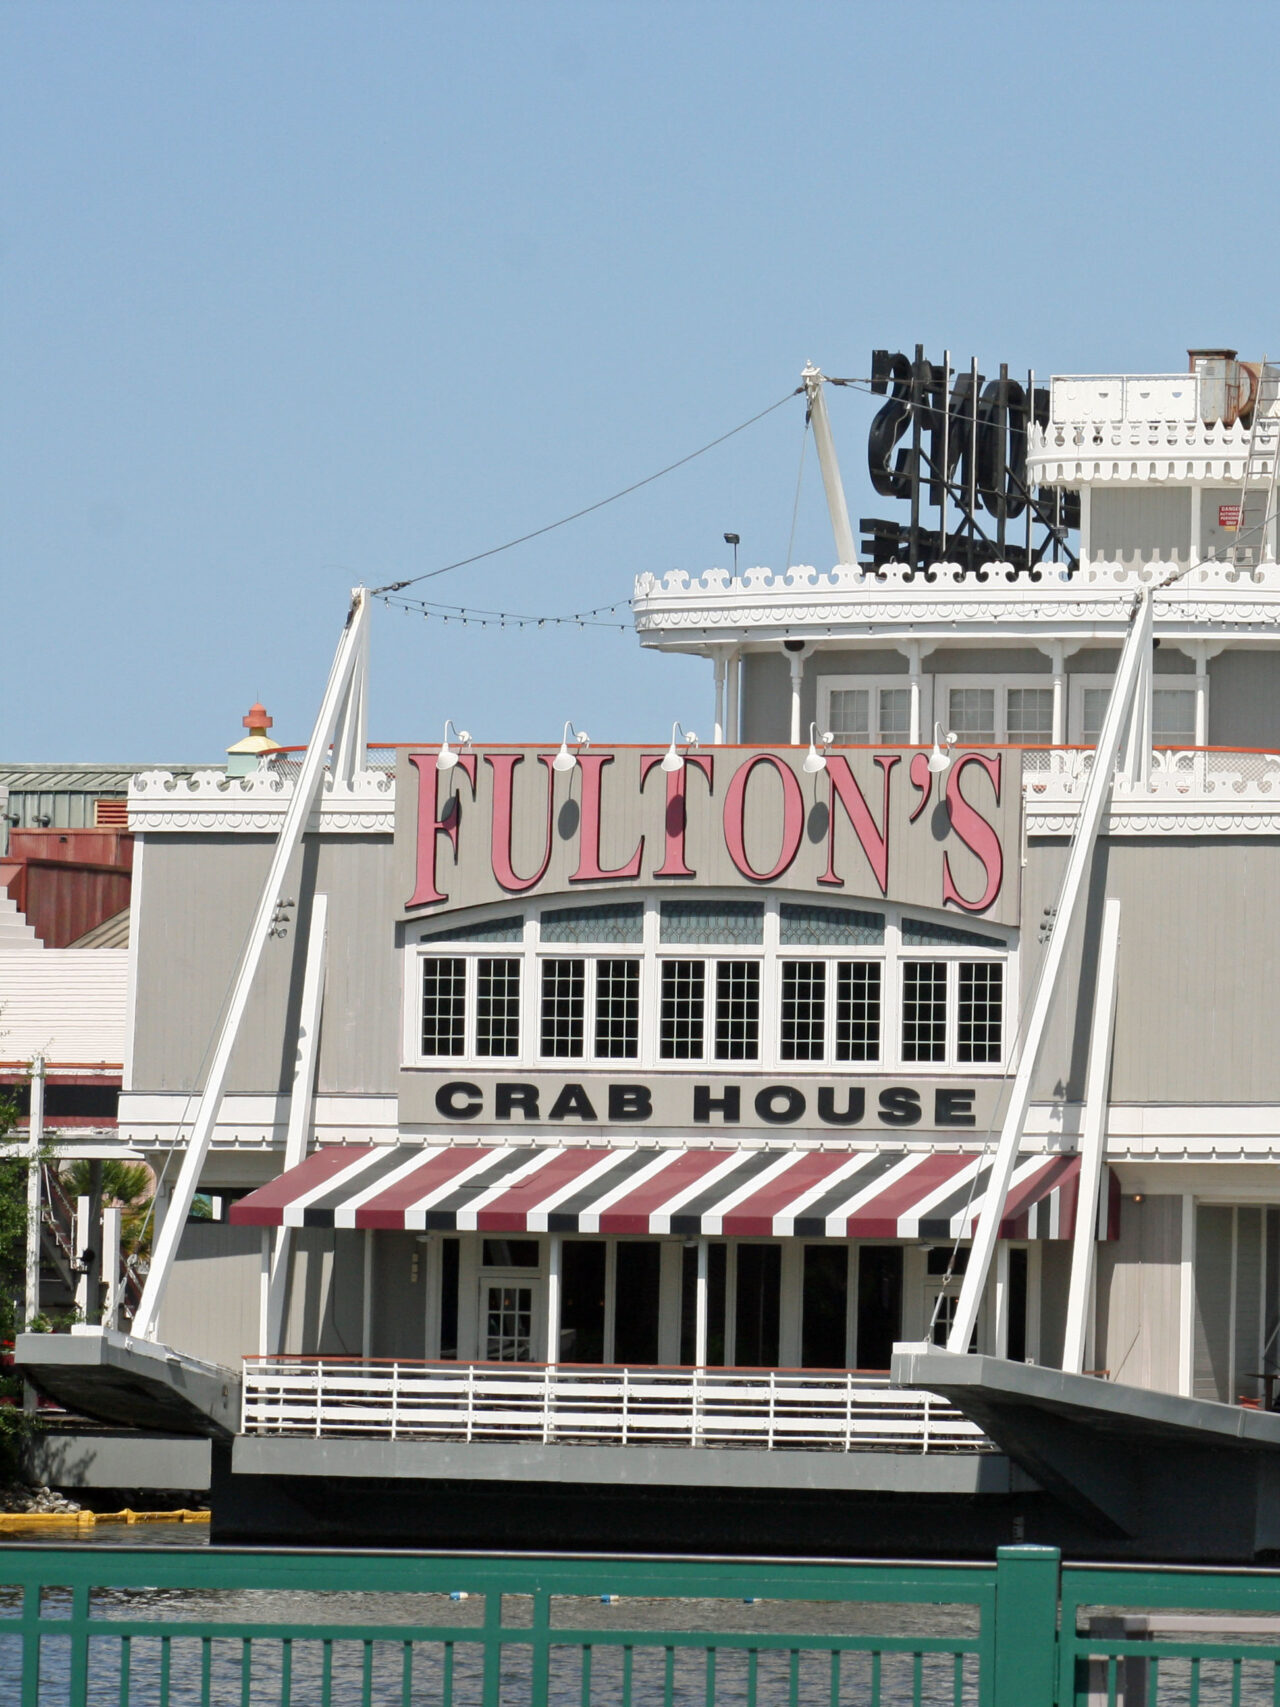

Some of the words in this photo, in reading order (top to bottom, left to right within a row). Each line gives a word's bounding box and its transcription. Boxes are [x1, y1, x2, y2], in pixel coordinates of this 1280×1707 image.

[405, 753, 1003, 912] FULTON'S
[435, 1080, 654, 1123] CRAB
[693, 1084, 977, 1126] HOUSE
